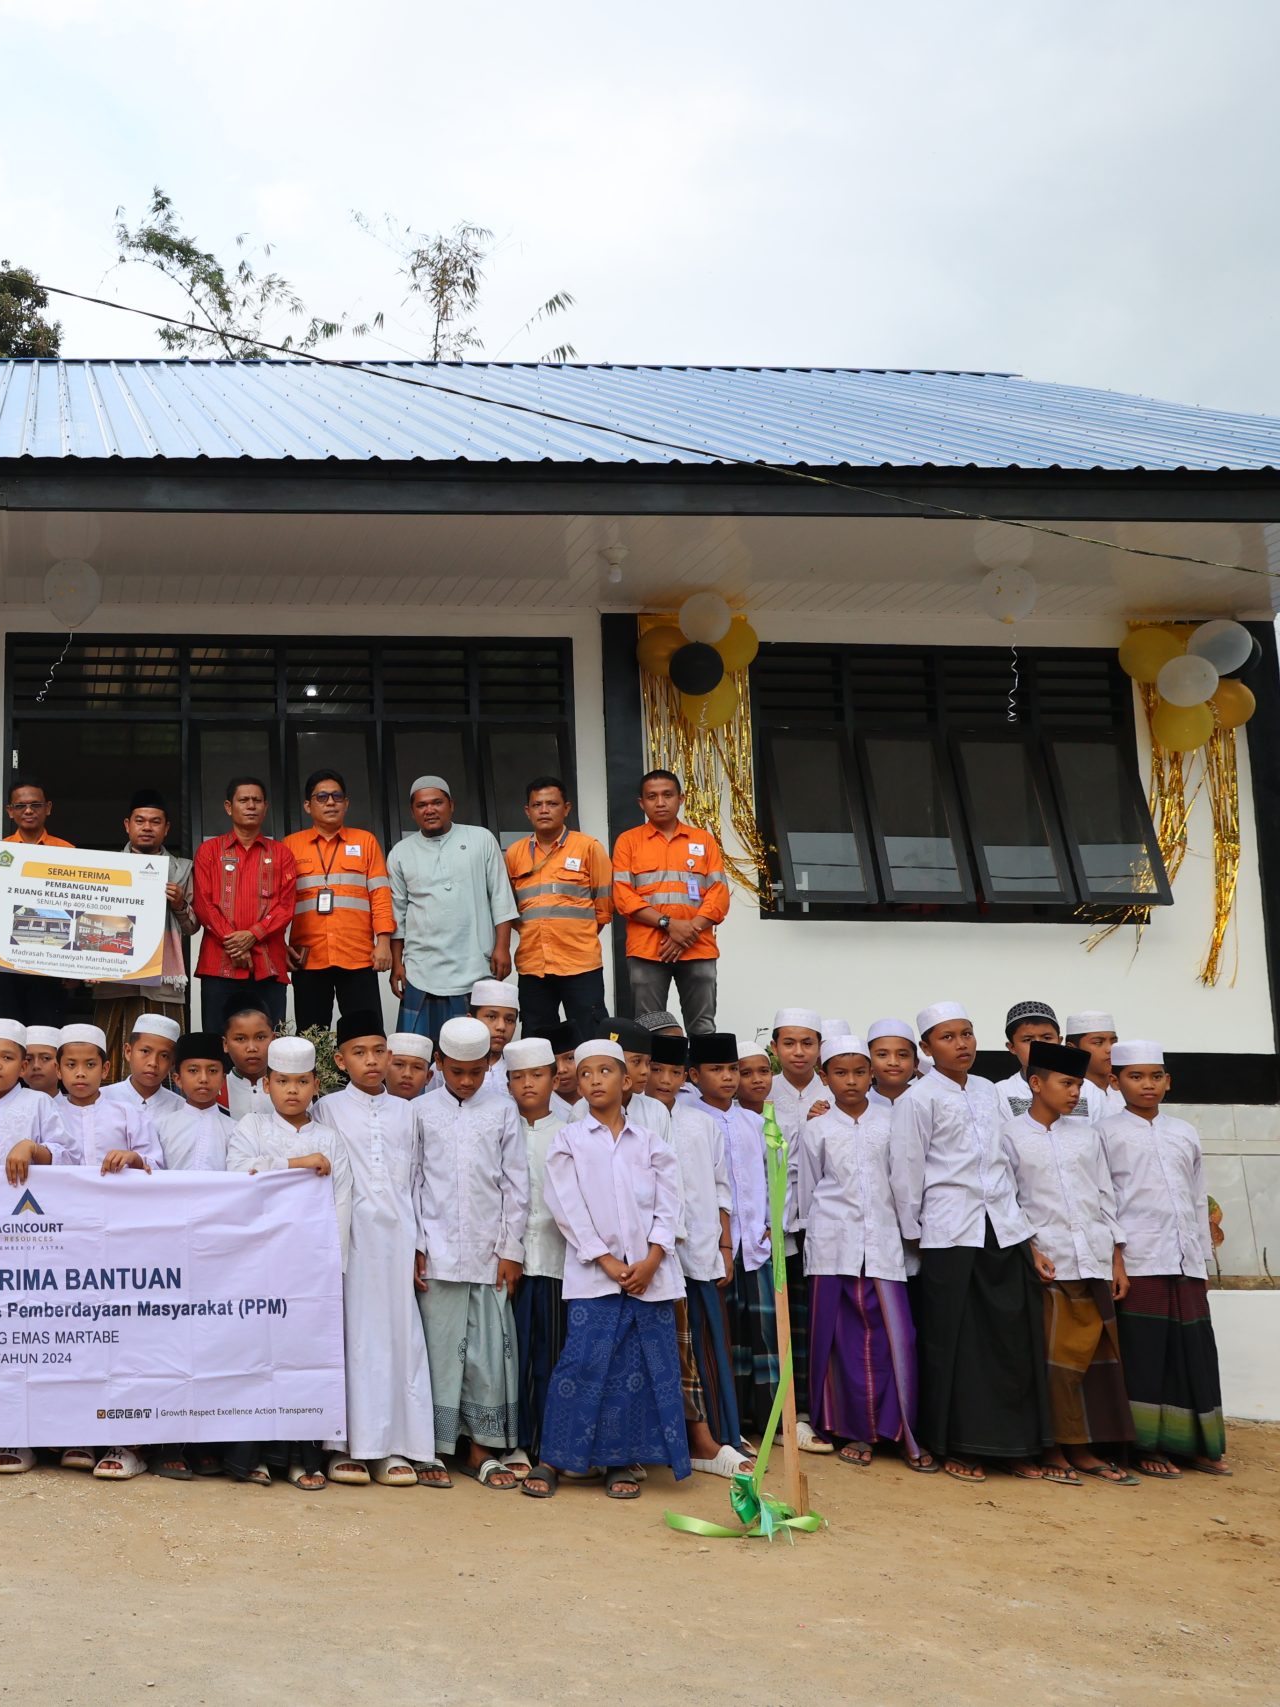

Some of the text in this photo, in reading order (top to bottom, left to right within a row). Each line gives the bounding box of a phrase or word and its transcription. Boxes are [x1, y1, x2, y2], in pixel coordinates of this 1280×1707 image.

[47, 867, 111, 881] SERAH TERIMA
[45, 880, 109, 893] PEMBANGUNAN
[14, 887, 43, 897] RUANG
[44, 890, 69, 899] KELAS
[70, 893, 93, 902] BARU
[100, 895, 145, 906] FURNITURE
[36, 898, 62, 906] SENILAI
[63, 900, 72, 908] Rp
[11, 948, 128, 965] Madrasah Tsanawiyah Mardhatillah
[65, 1267, 182, 1290] BANTUAN
[7, 1301, 132, 1322] Pemberdayaan
[137, 1300, 234, 1321] Masyarakat
[238, 1298, 287, 1319] (PPM)
[12, 1331, 50, 1345] EMAS
[55, 1330, 120, 1344] MARTABE
[42, 1353, 72, 1364] 2024
[106, 1406, 324, 1419] GREAT Growth Respect Excellence Action Transparency
